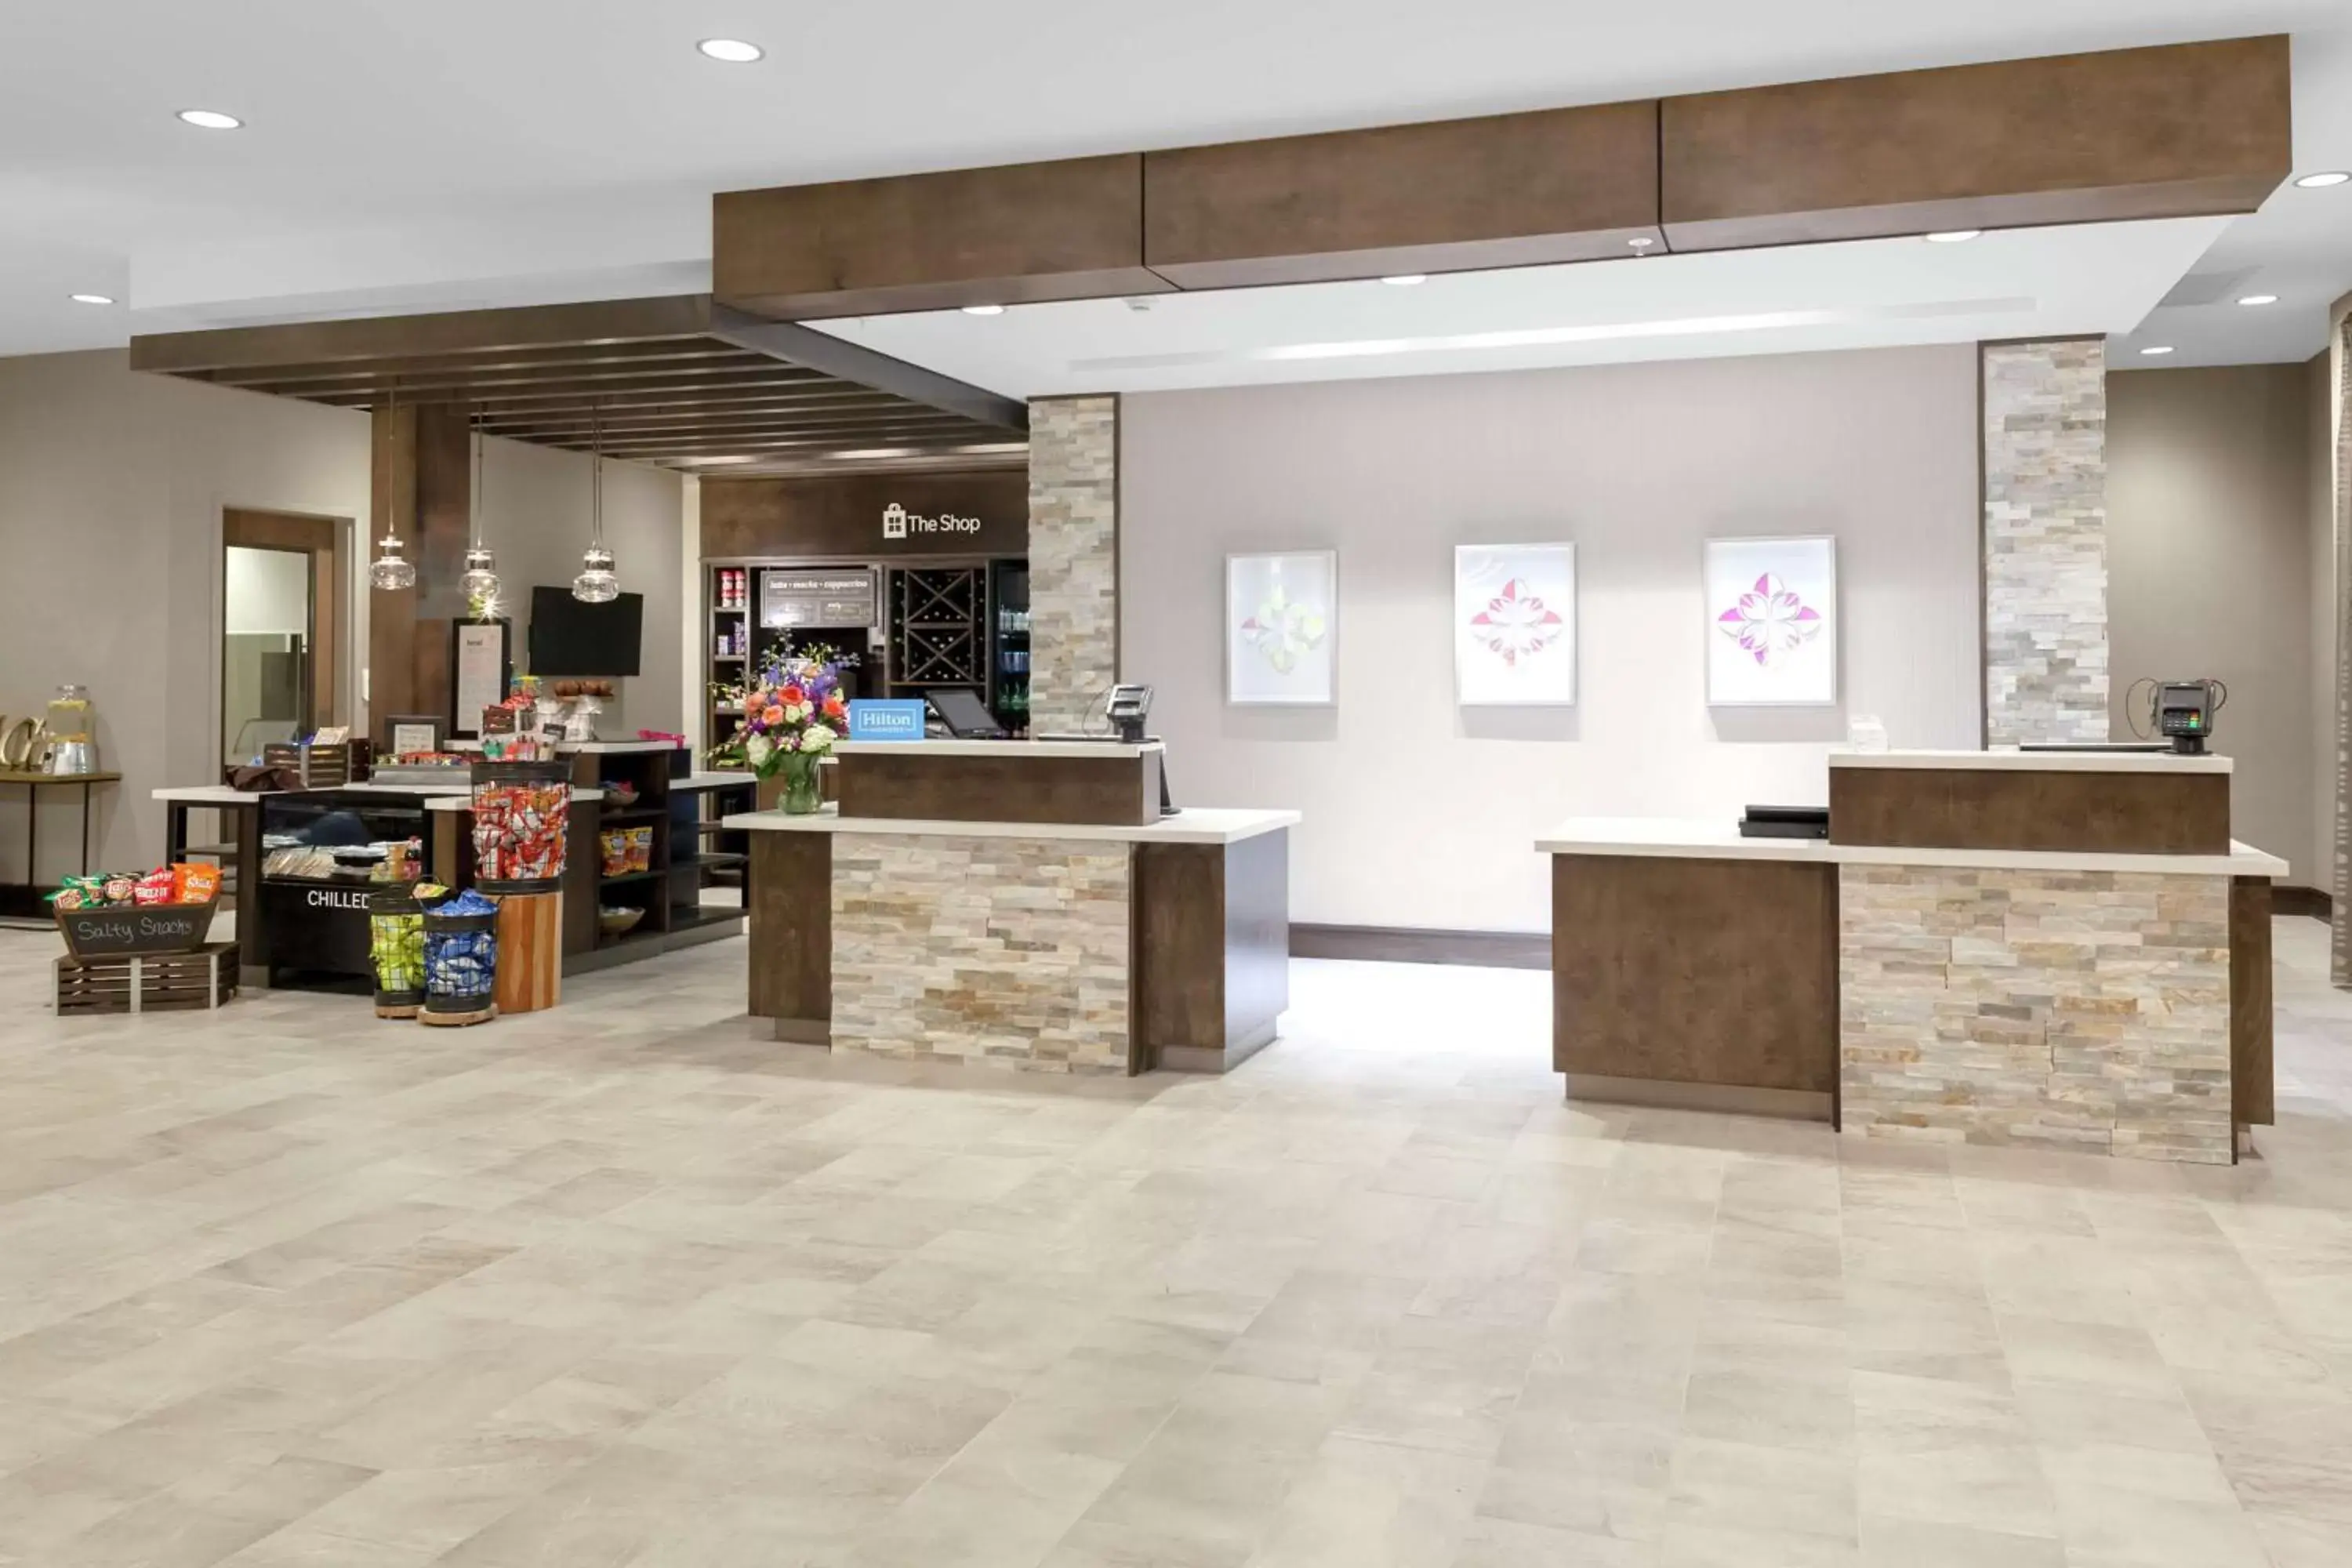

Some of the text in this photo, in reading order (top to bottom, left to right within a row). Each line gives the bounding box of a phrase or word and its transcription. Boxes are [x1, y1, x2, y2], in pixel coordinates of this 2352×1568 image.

[907, 514, 981, 534] The Shop
[862, 711, 911, 726] Hilton
[78, 916, 193, 943] Salty Snacks
